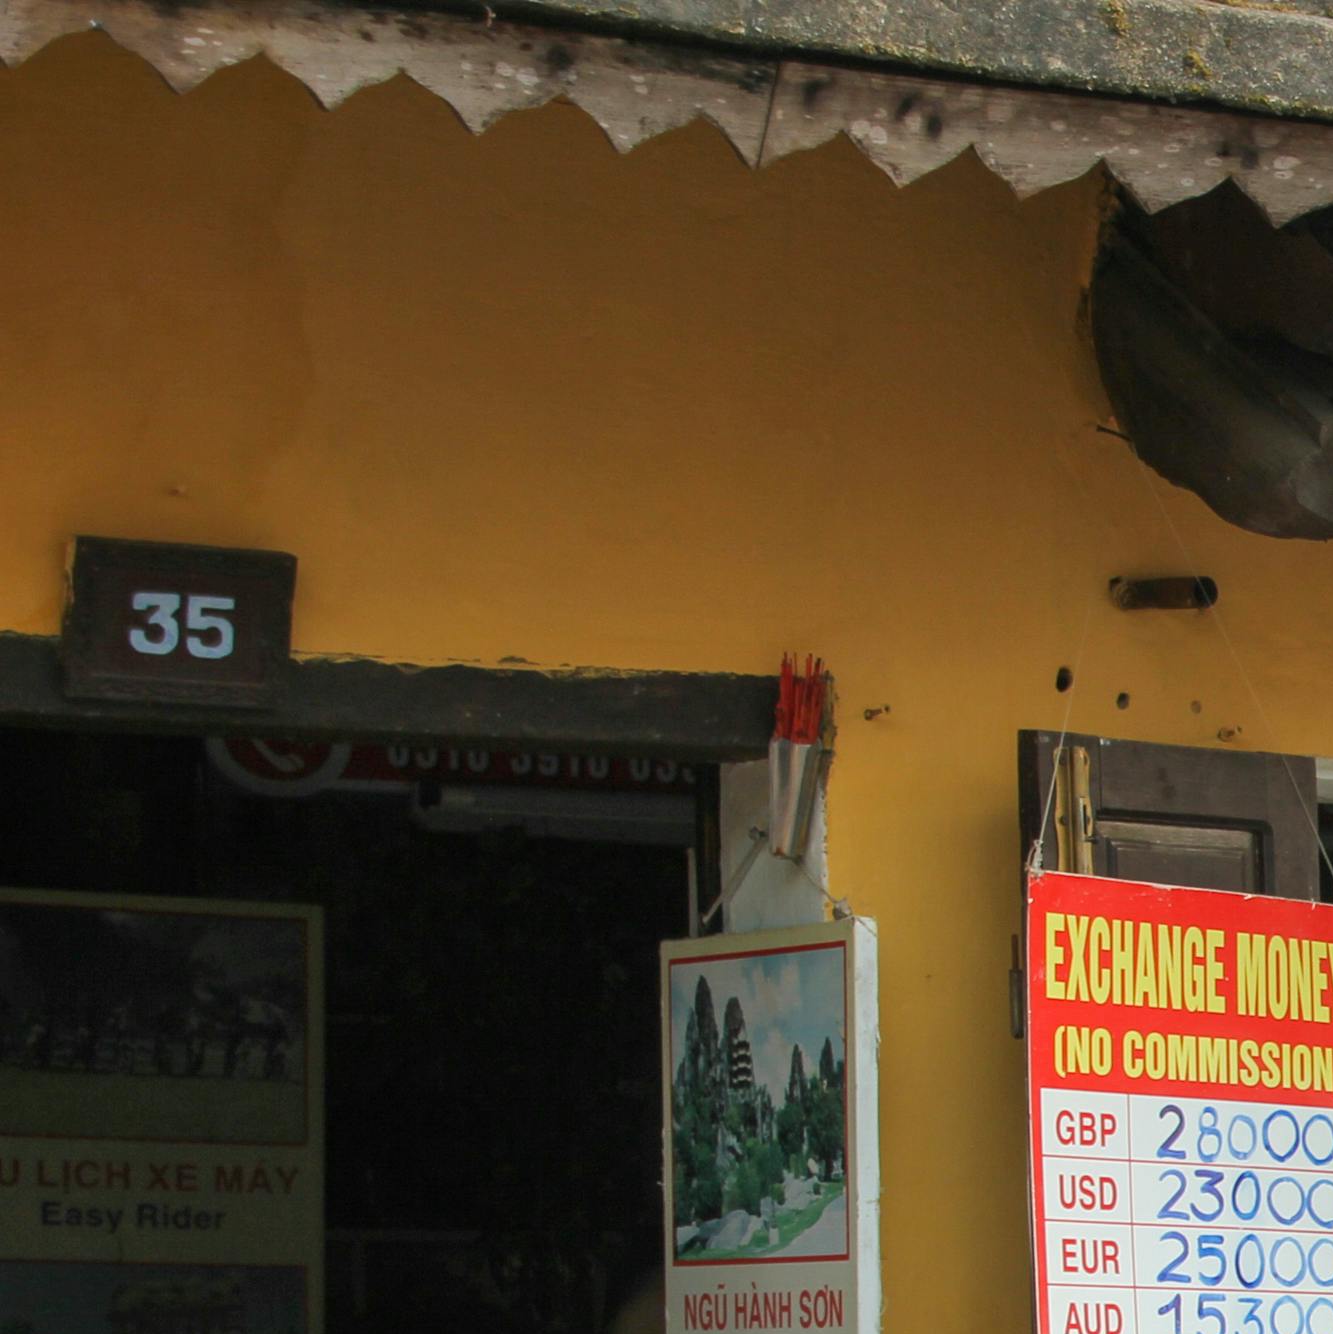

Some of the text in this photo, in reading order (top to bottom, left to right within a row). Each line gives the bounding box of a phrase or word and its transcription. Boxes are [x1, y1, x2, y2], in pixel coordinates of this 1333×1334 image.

[128, 591, 236, 660] 35
[1045, 911, 1226, 1014] EXCHANGE
[1054, 1025, 1112, 1078] (NO
[1055, 1109, 1117, 1147] GBP
[147, 1162, 199, 1192] XE
[1059, 1174, 1118, 1211] USD
[41, 1201, 226, 1233] Easy Rider
[1061, 1238, 1120, 1275] EUR
[684, 1282, 843, 1331] NGŨ HÀNH SƠN
